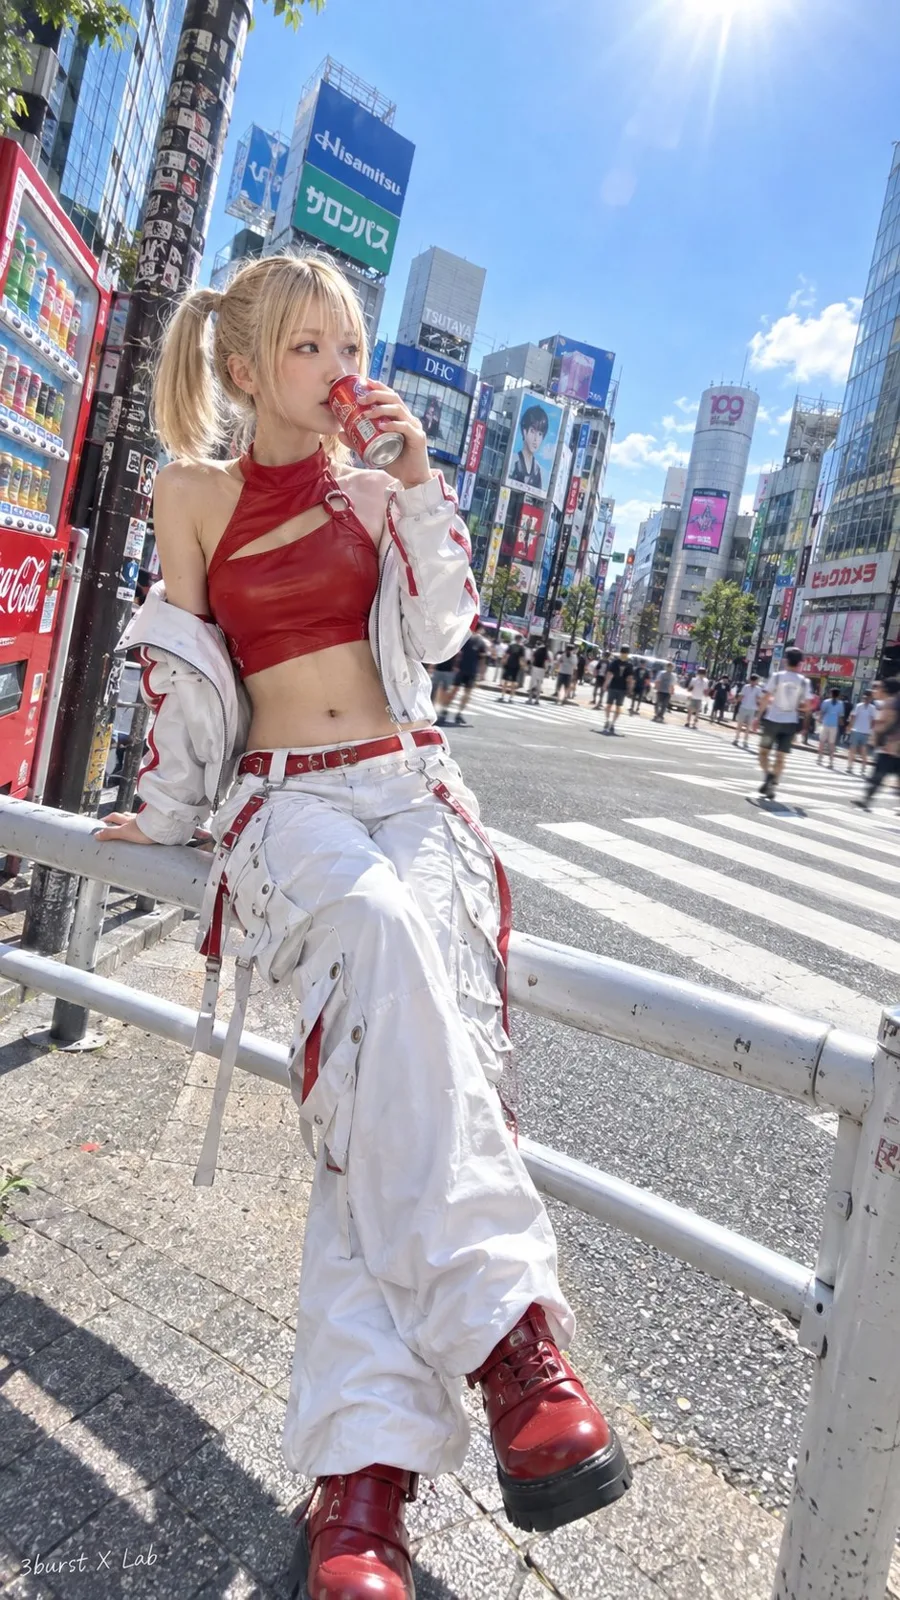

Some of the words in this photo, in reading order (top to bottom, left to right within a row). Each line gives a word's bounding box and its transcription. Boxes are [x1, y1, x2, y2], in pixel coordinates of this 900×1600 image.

[314, 130, 401, 196] Hisamitsu
[305, 185, 390, 254] サロンパス
[424, 308, 471, 339] TSUTAYA
[425, 358, 454, 381] DHC
[711, 395, 744, 421] 109
[811, 563, 877, 589] ビックカメラ
